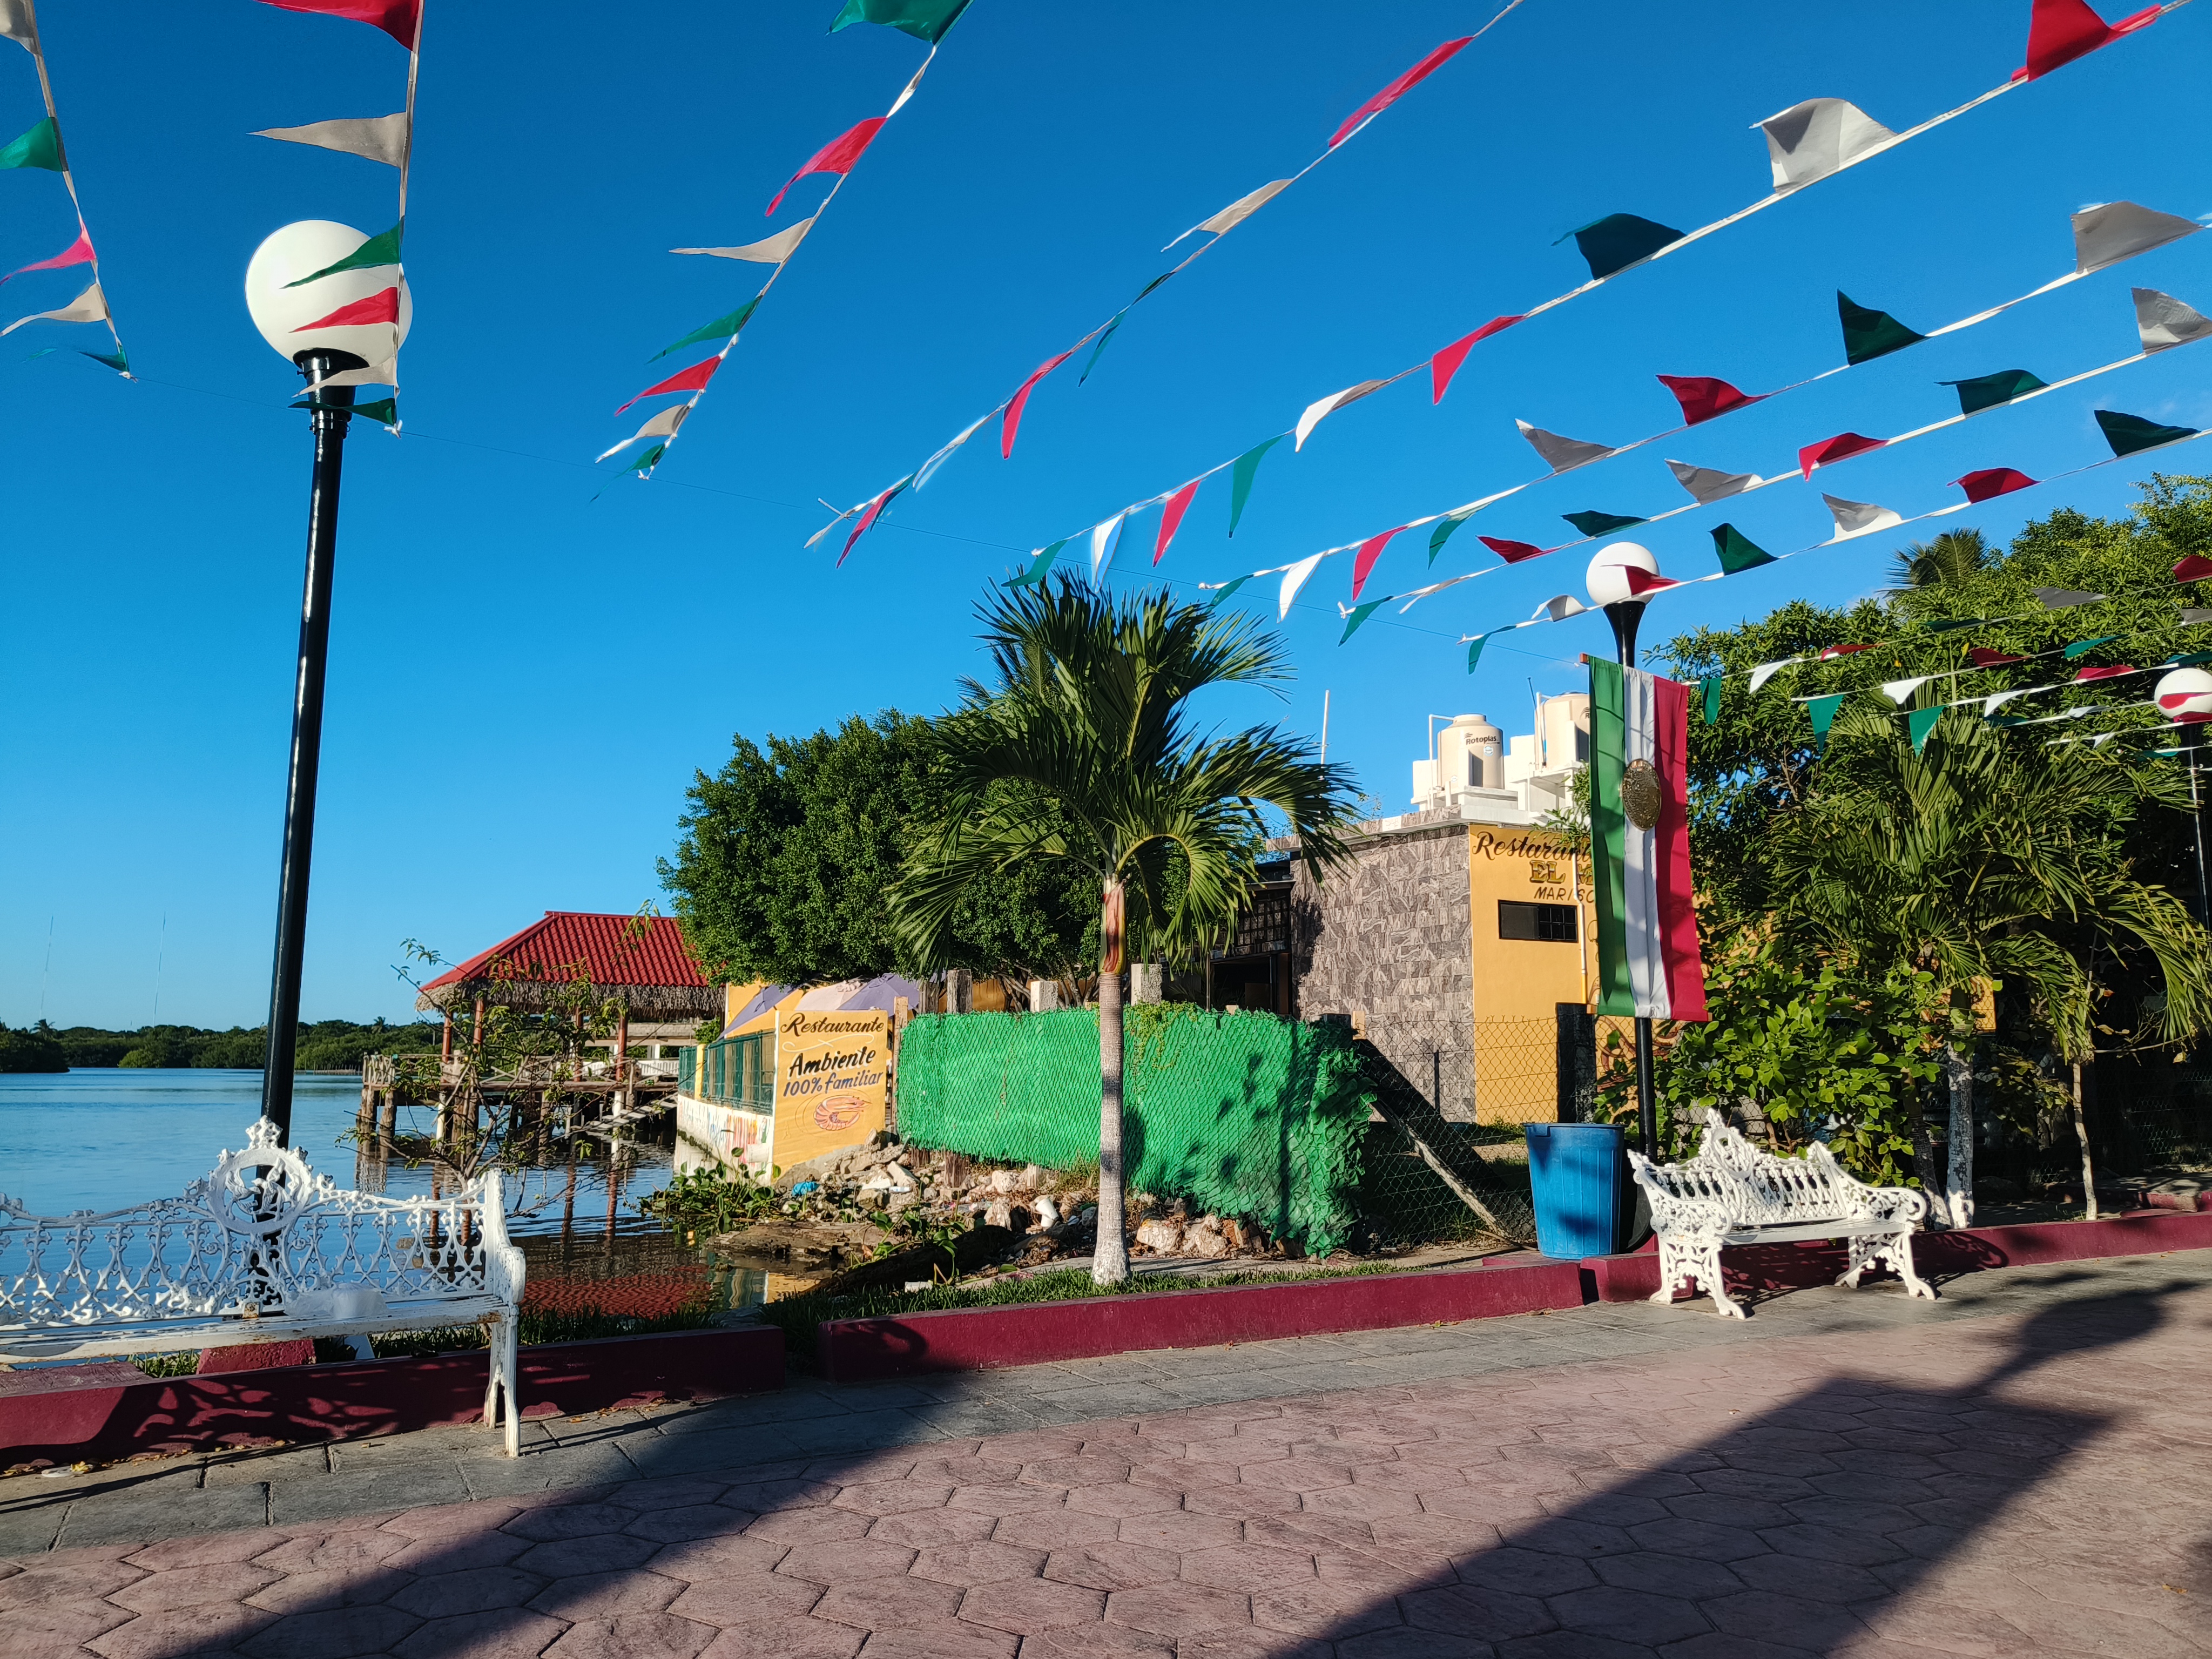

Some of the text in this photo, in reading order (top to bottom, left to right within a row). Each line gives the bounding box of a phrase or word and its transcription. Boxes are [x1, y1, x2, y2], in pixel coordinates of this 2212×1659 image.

[1466, 736, 1496, 745] Rotoplas
[1472, 831, 1592, 862] Restarant
[1530, 860, 1566, 884] EL
[1534, 887, 1595, 903] MARISC
[780, 1013, 884, 1037] Restaurante
[788, 1046, 876, 1078] Ambiente
[783, 1070, 884, 1097] 100% familiar
